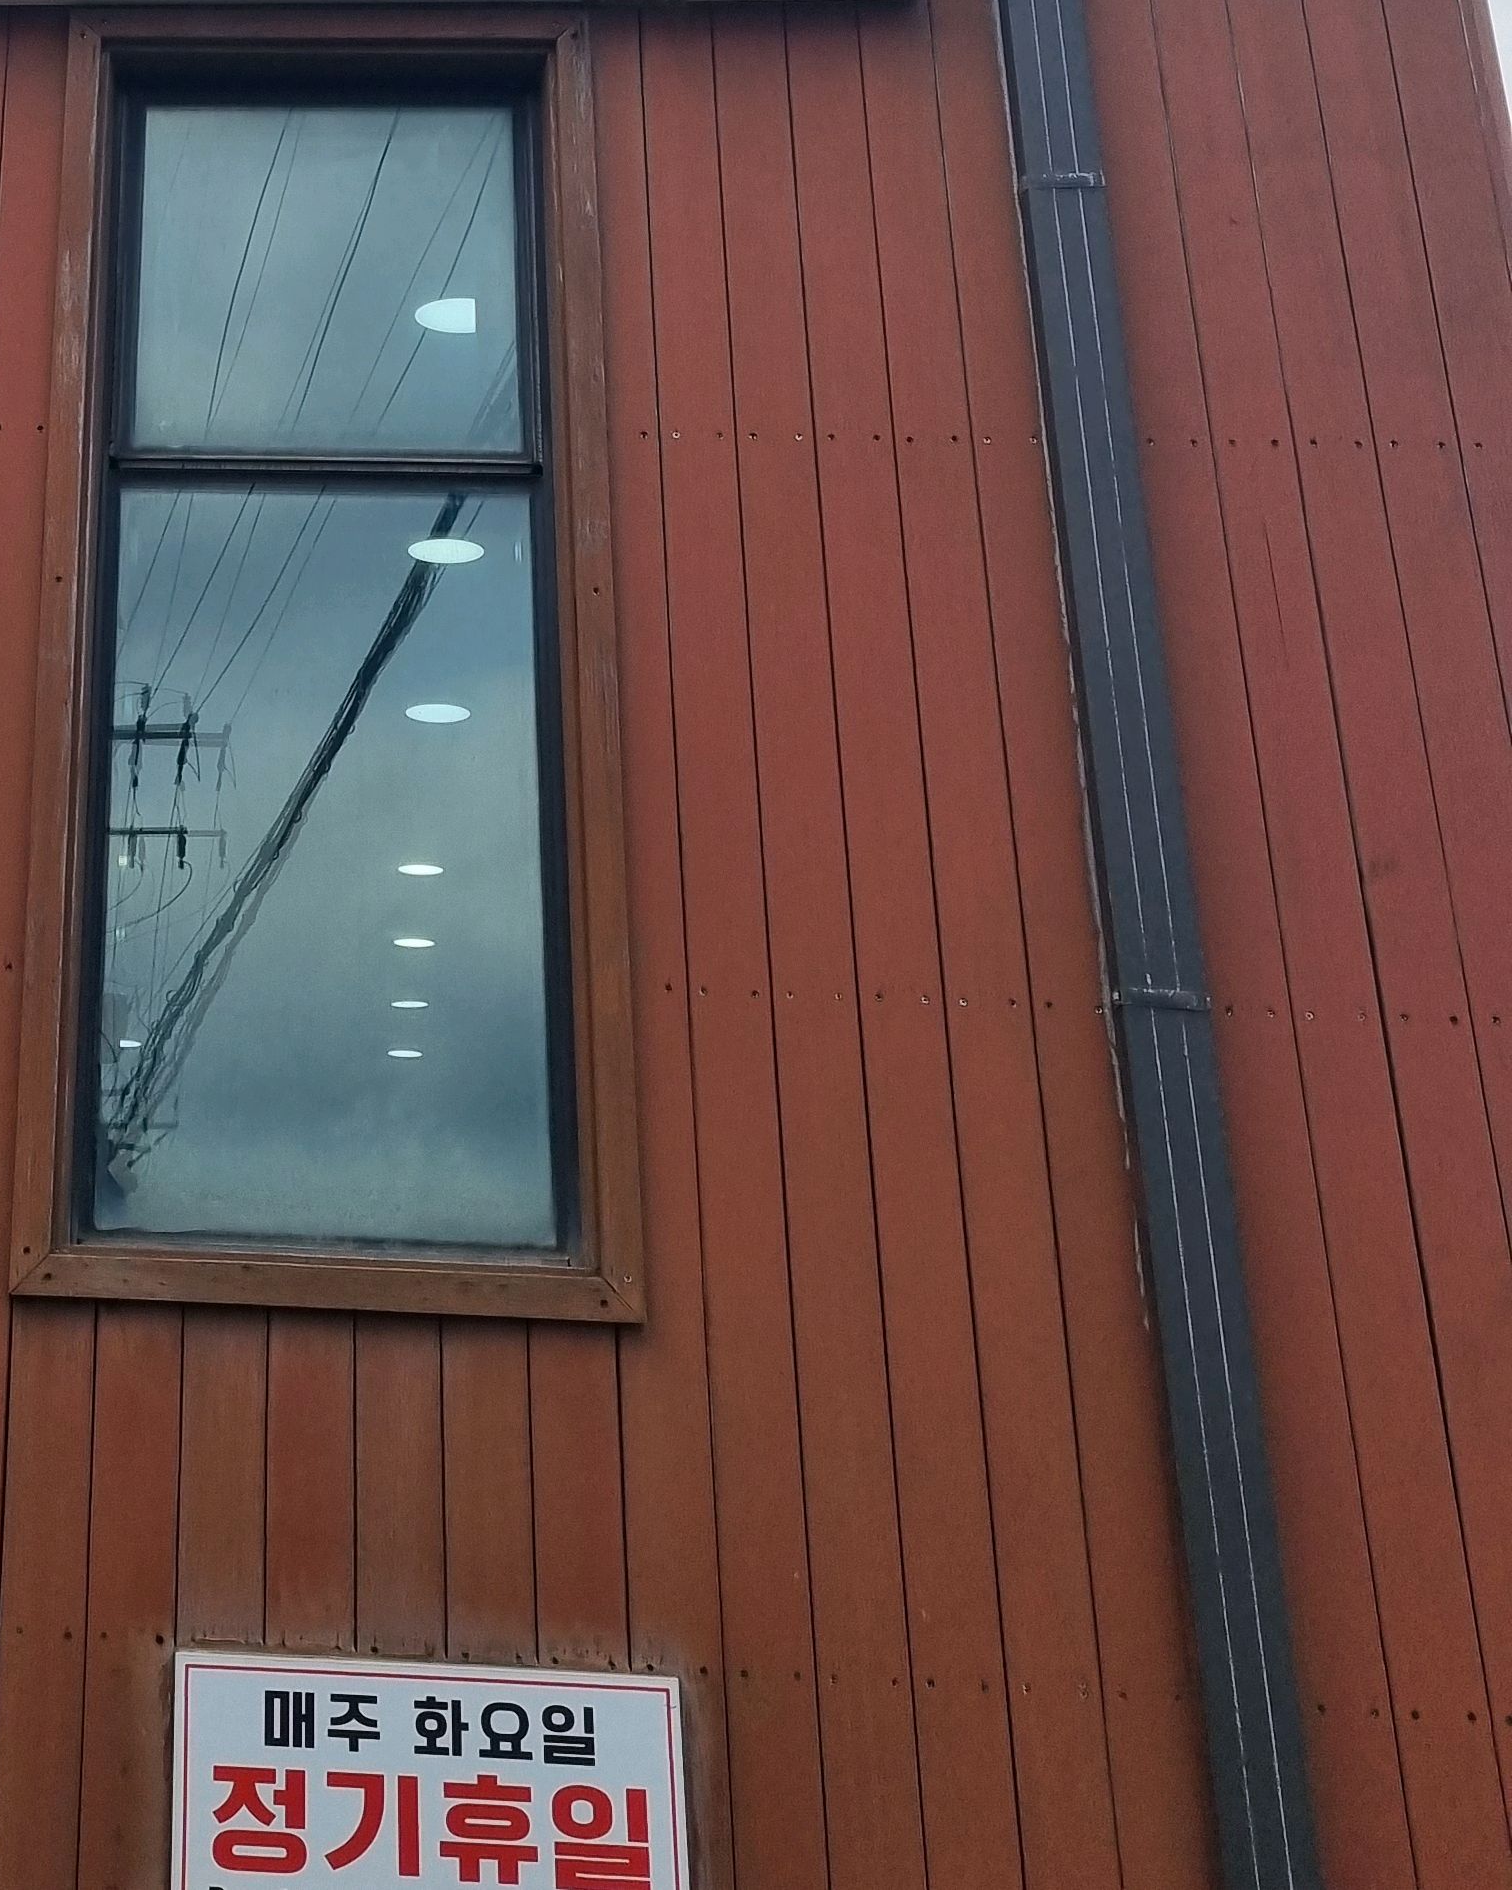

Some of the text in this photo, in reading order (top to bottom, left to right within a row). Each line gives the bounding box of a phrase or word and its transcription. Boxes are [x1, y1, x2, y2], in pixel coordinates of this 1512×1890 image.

[262, 1689, 598, 1768] 매주 화요일
[210, 1764, 653, 1890] 정기휴일
